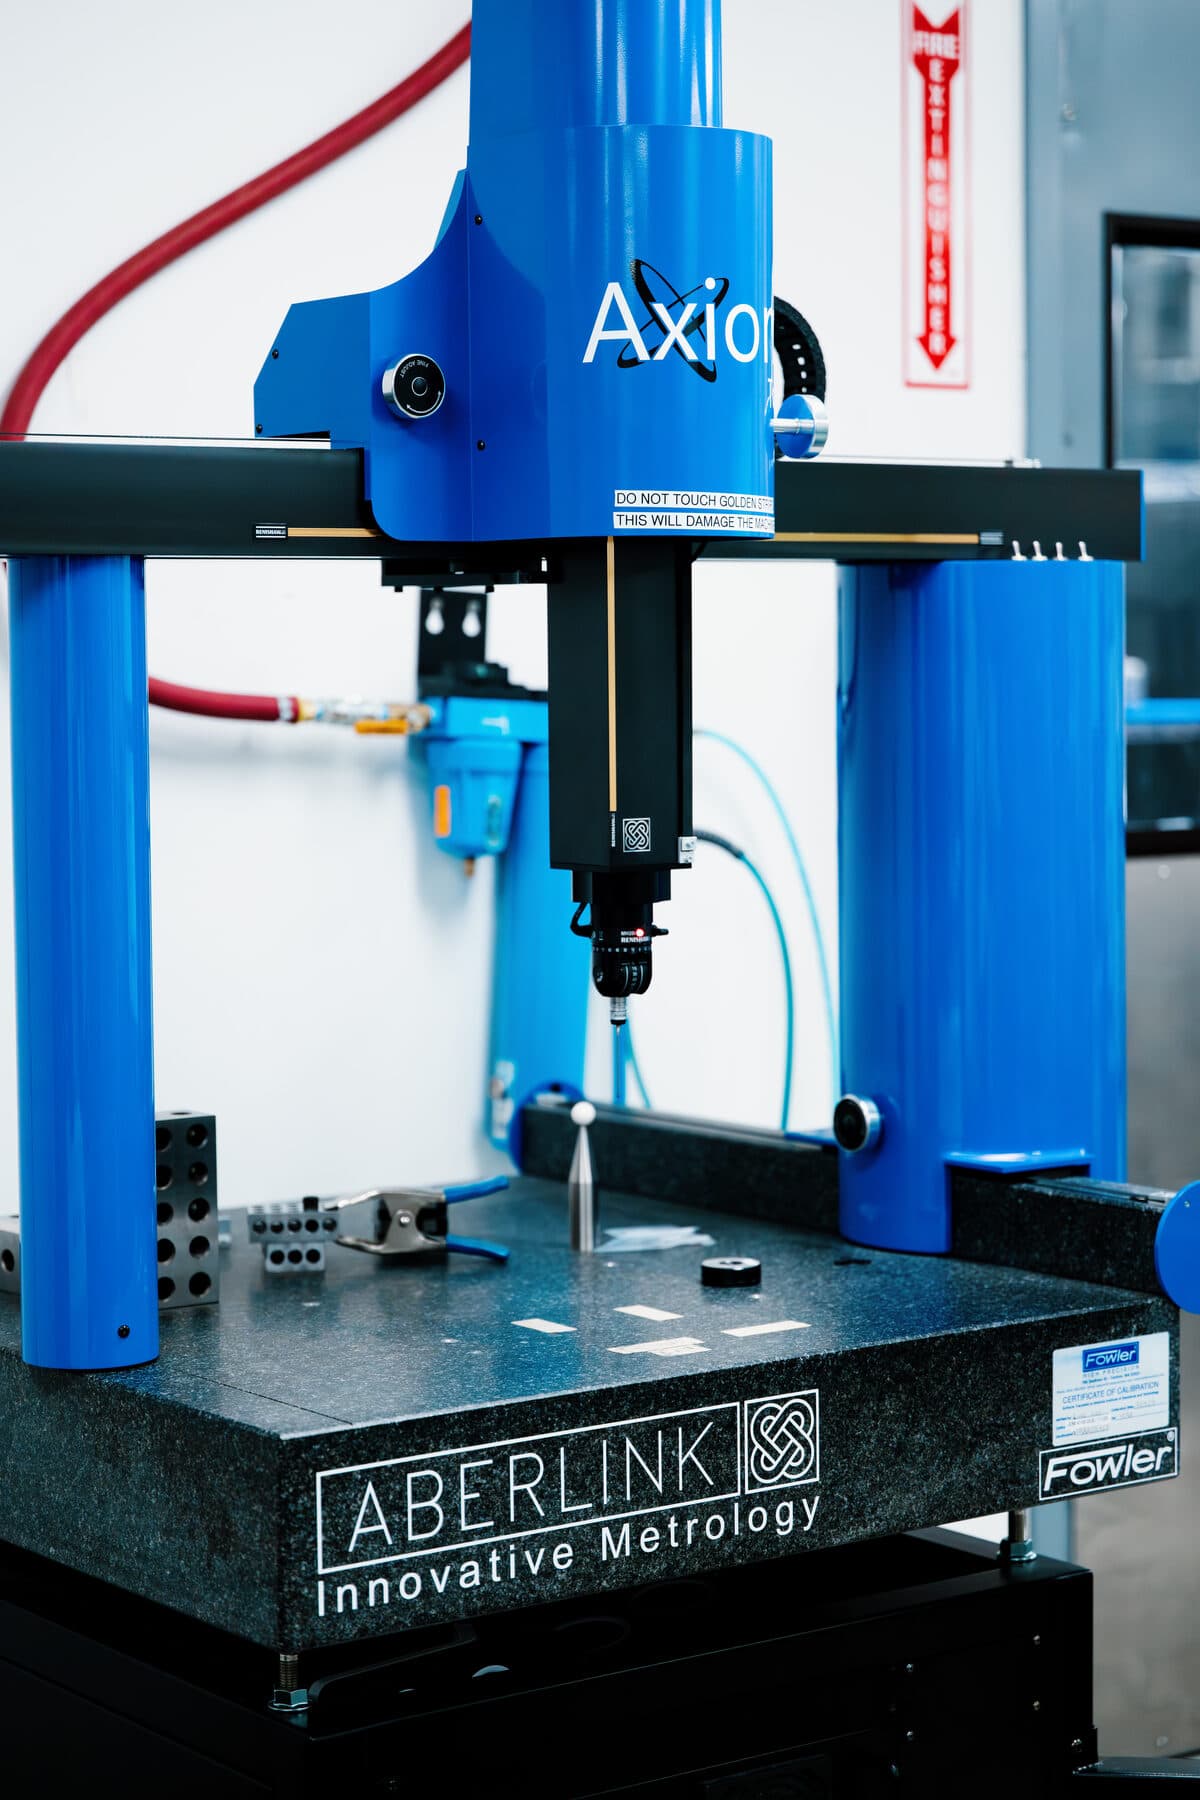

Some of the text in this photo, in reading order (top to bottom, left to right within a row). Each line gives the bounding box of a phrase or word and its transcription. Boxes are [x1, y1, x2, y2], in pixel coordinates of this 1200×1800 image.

[616, 492, 637, 504] DO
[641, 493, 669, 505] NOT
[673, 493, 716, 507] TOUCH
[719, 495, 757, 509] GOLDEN
[616, 514, 648, 526] THIS
[651, 515, 682, 527] WILL
[686, 515, 734, 528] DAMAGE
[737, 516, 753, 529] THE
[1085, 1348, 1137, 1368] Fowler
[1062, 1389, 1105, 1404] CERTIFICATE
[1106, 1388, 1115, 1397] OF
[1117, 1381, 1159, 1395] CALIBRATION
[1043, 1444, 1172, 1491] Fowler
[348, 1421, 715, 1553] ABERLINK
[317, 1496, 820, 1617] Innovative Metrology
